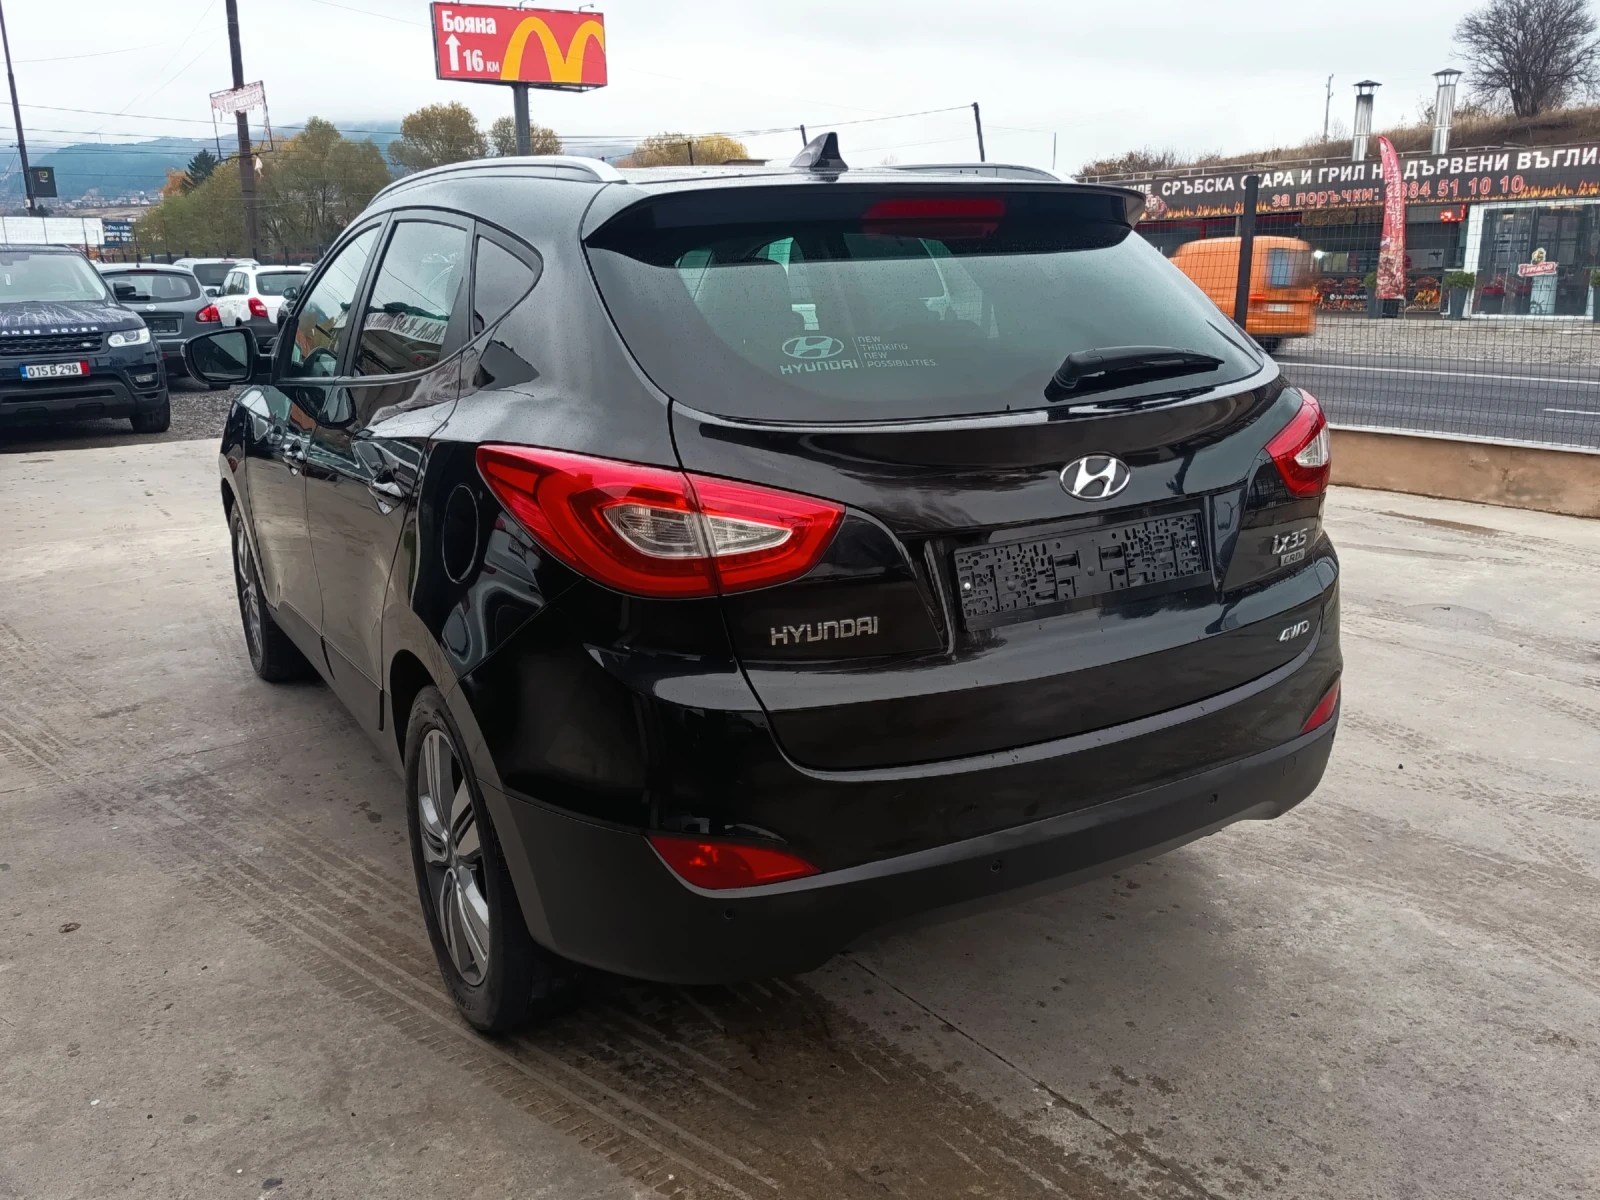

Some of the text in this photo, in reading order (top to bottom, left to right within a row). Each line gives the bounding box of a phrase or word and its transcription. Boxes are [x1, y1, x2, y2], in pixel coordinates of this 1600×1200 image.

[441, 10, 497, 35] Бояна
[462, 49, 485, 72] 16
[1161, 176, 1235, 196] СРЪБСКА
[1240, 170, 1296, 190] САРА
[1300, 169, 1312, 185] И
[1317, 164, 1366, 183] ГРИЛ
[1403, 153, 1510, 180] ДЪРВЕНИ
[1516, 146, 1600, 171] ВЪГЛИ
[1271, 193, 1291, 207] за
[1295, 187, 1380, 209] поръчки:
[1437, 178, 1460, 197] 51
[1468, 176, 1492, 195] 10
[1499, 174, 1524, 194] 10
[860, 343, 911, 351] THINKING.
[779, 359, 859, 375] HYUNDAI
[866, 359, 939, 368] POSSIBILITIES.
[1272, 528, 1308, 555] ix35
[770, 616, 879, 646] HYUNDAI
[1279, 620, 1310, 642] 4WD
